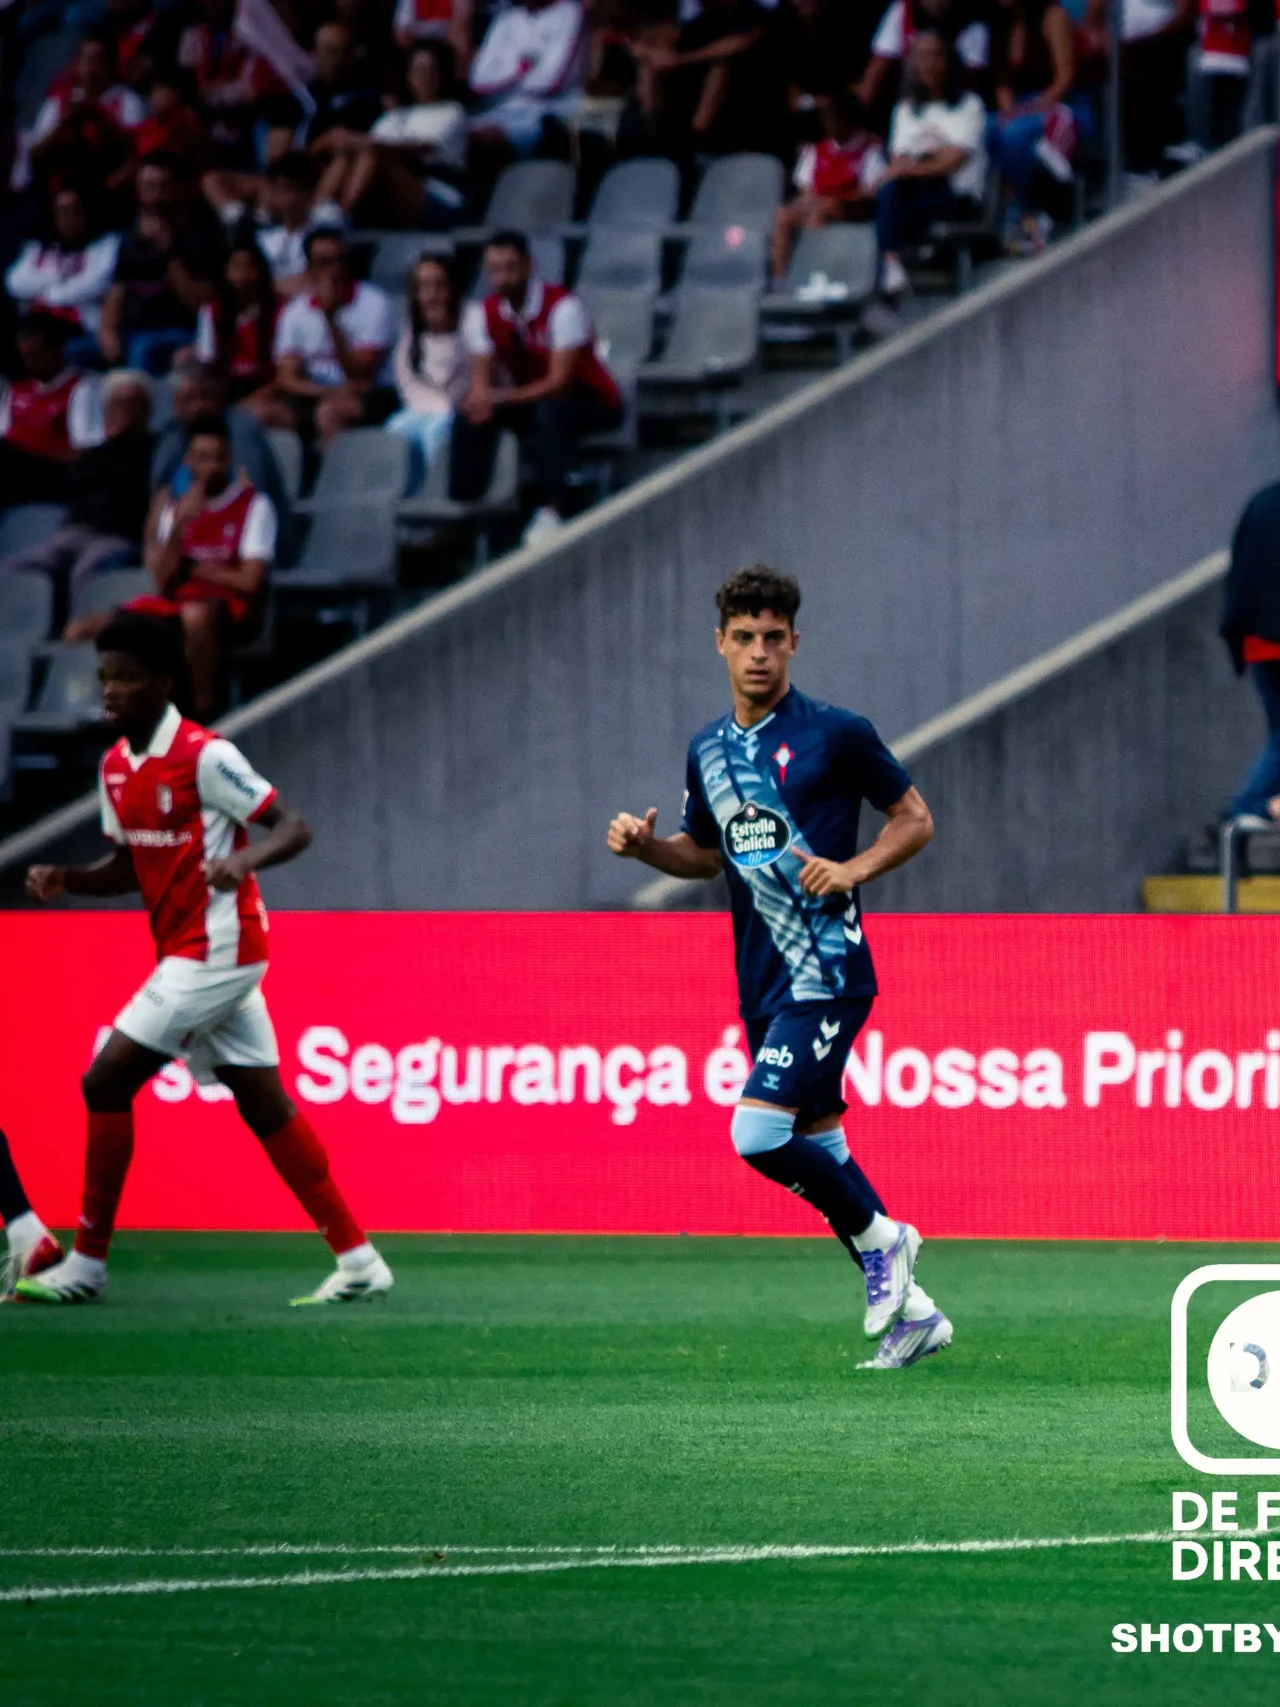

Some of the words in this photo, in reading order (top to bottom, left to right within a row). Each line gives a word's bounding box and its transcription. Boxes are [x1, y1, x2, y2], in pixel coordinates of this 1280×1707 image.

[730, 817, 777, 838] Estrella
[734, 833, 776, 854] Galicia
[296, 1025, 692, 1126] Segurança
[702, 1025, 748, 1107] é
[841, 1029, 1069, 1109] Nossa
